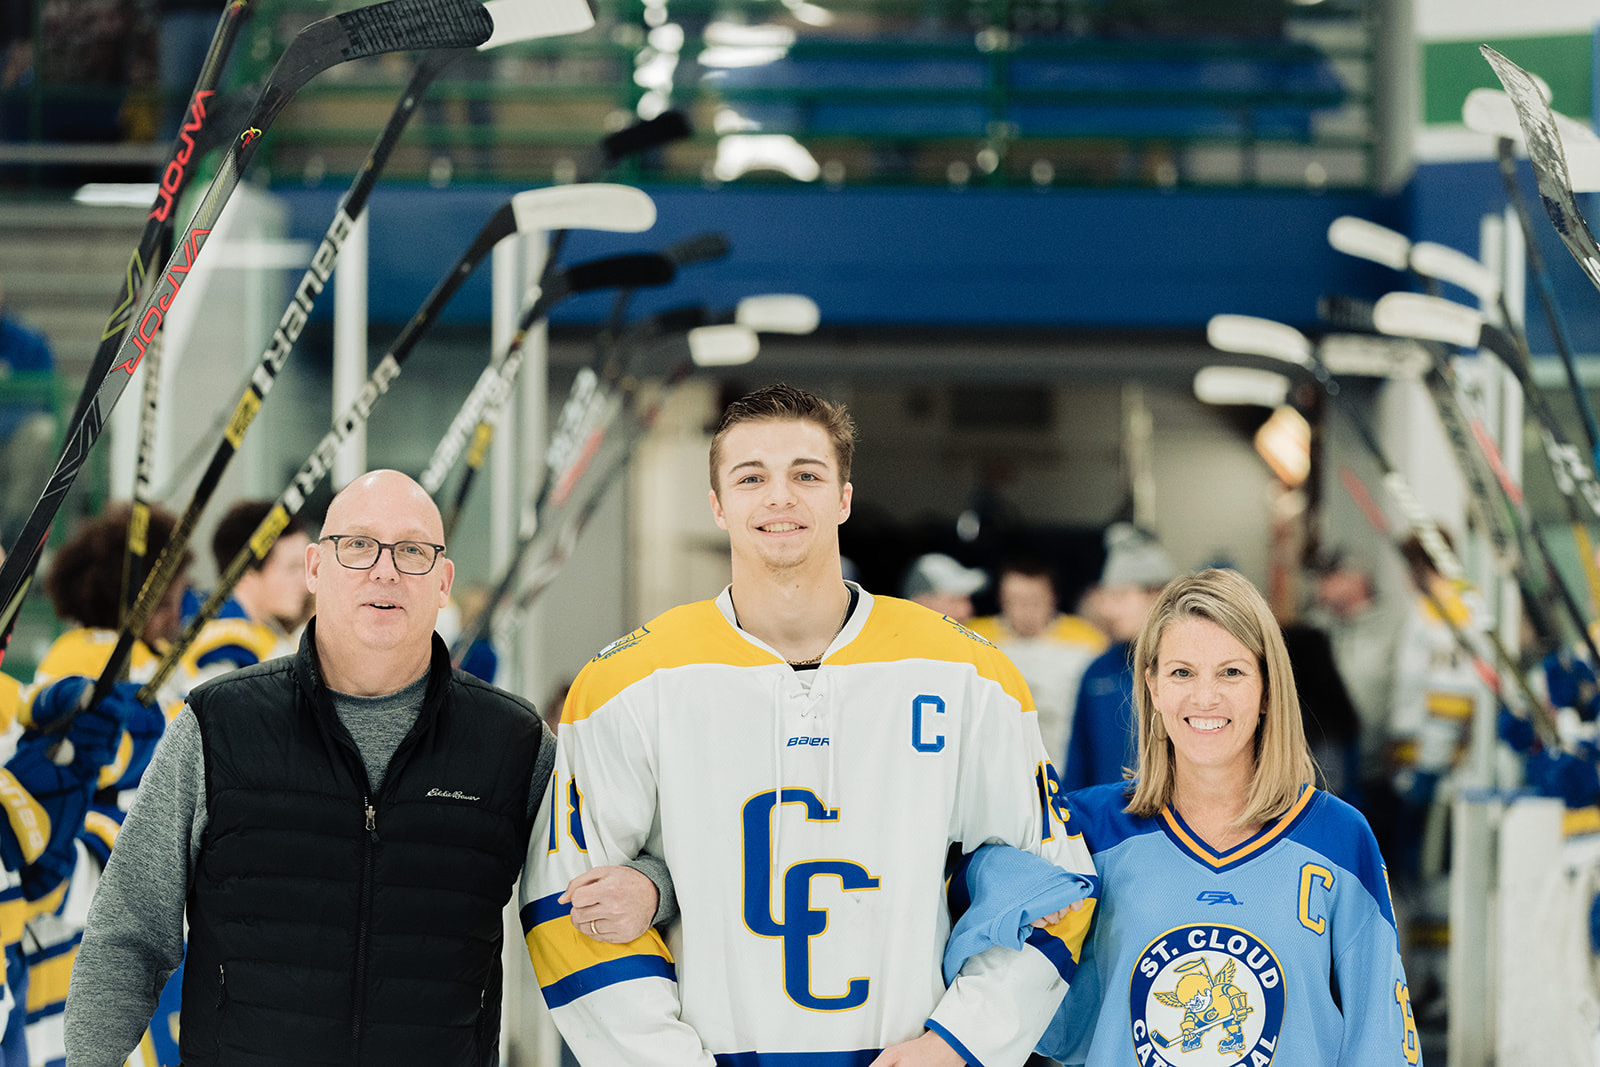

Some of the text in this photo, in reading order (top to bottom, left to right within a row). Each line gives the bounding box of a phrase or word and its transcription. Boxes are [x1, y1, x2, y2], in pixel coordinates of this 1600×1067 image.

[147, 89, 215, 222] VAPOR
[112, 229, 211, 375] VAPOR
[911, 695, 946, 753] C
[1297, 861, 1335, 936] C
[1140, 929, 1280, 989] ST. CLOUD
